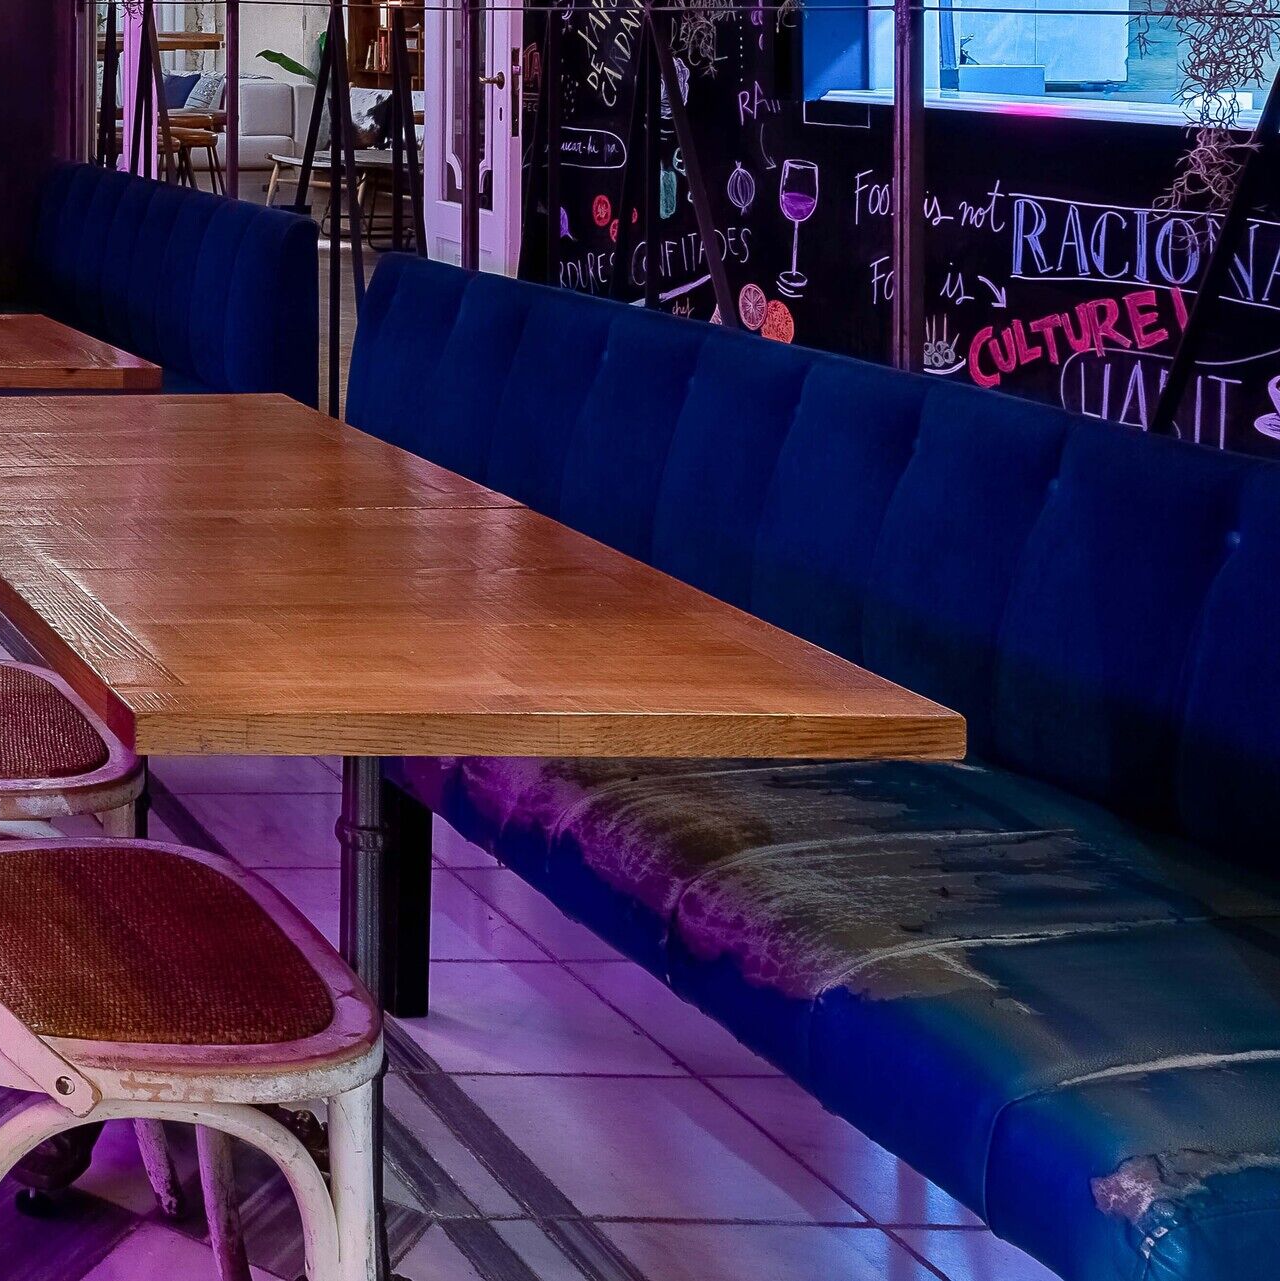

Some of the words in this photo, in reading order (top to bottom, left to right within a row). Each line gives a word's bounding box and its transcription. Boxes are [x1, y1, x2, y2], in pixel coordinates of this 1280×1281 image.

[586, 54, 604, 91] DE
[855, 170, 895, 225] Foo
[922, 191, 954, 226] is
[958, 179, 1006, 233] not
[939, 262, 975, 306] is
